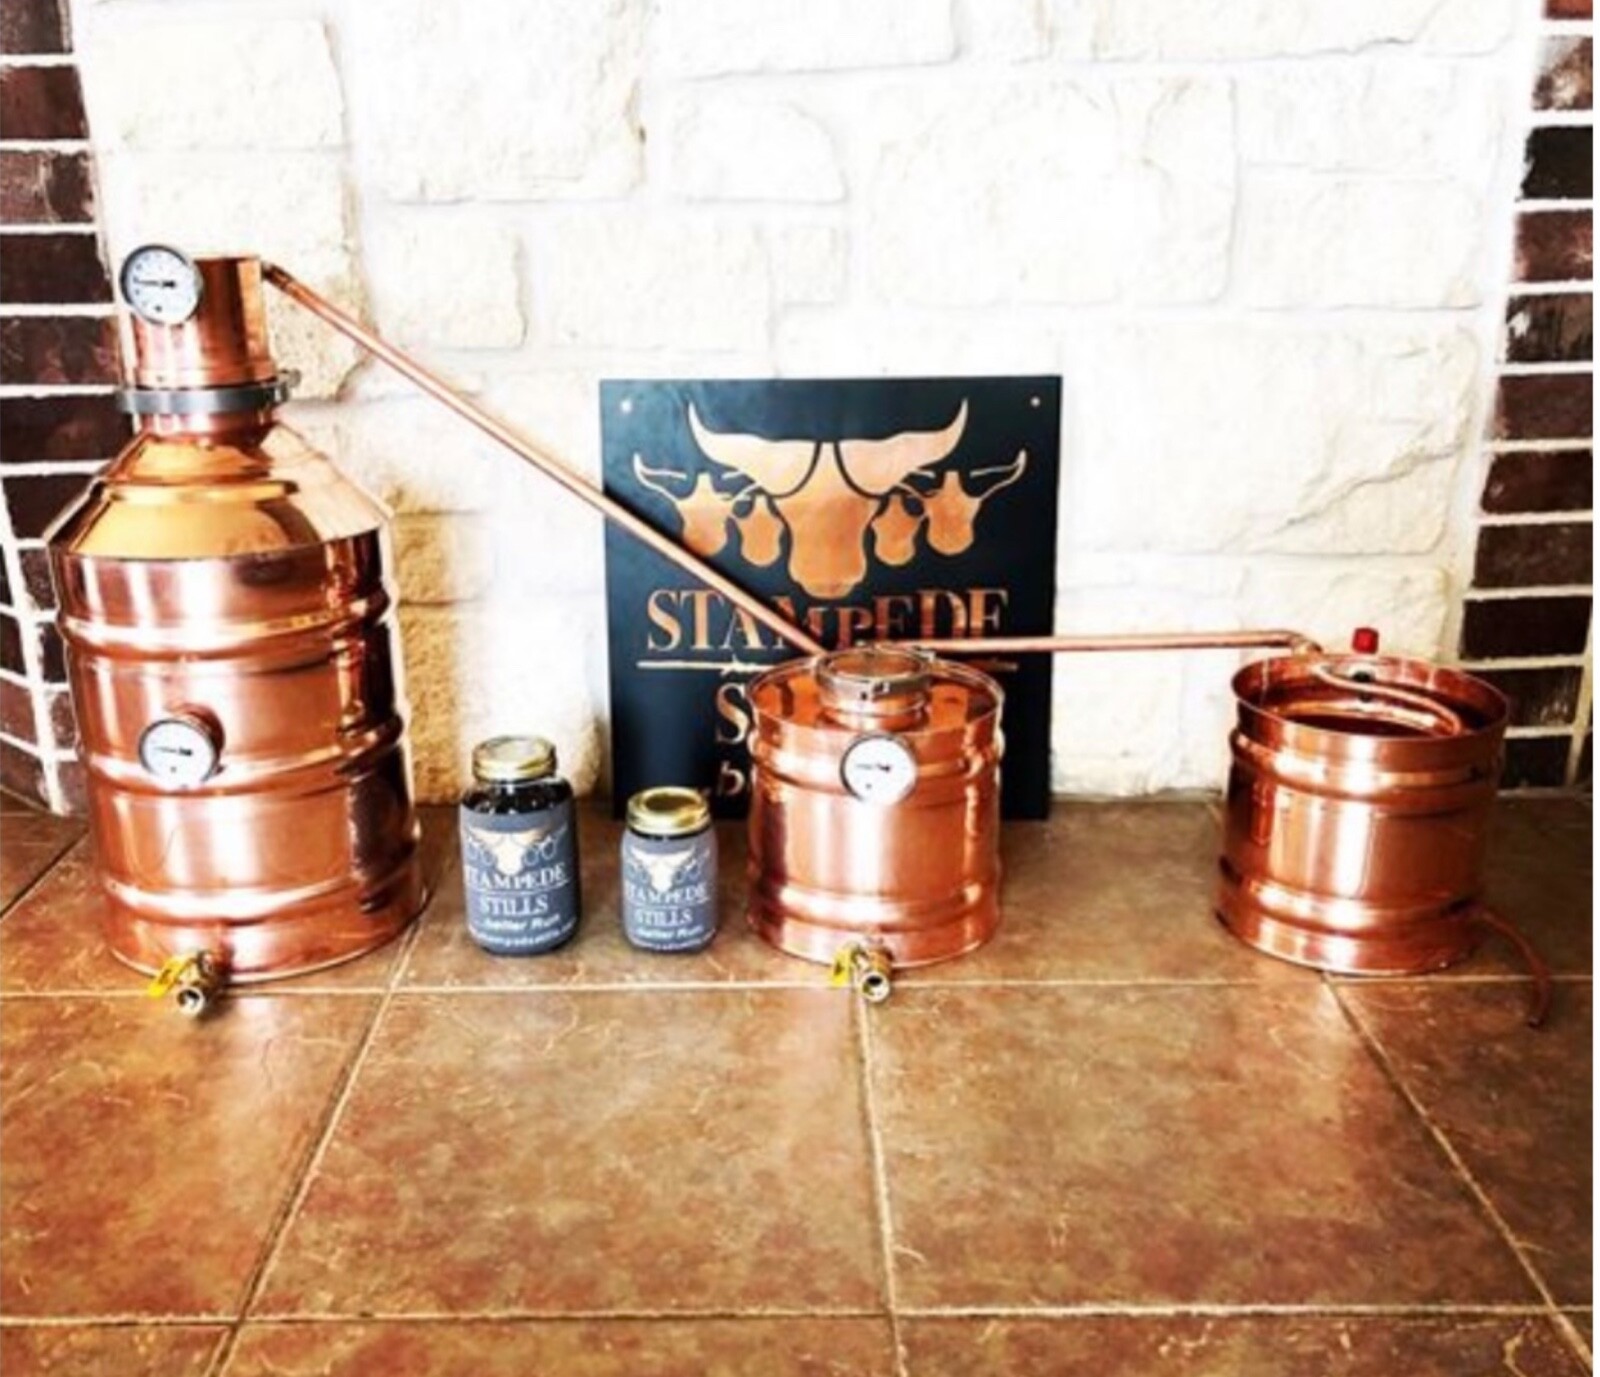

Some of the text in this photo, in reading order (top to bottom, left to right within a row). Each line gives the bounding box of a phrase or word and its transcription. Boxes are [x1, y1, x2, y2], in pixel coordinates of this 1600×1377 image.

[647, 588, 1009, 650] STAMPEDE
[479, 894, 549, 916] STILLS
[634, 908, 693, 927] STILLS
